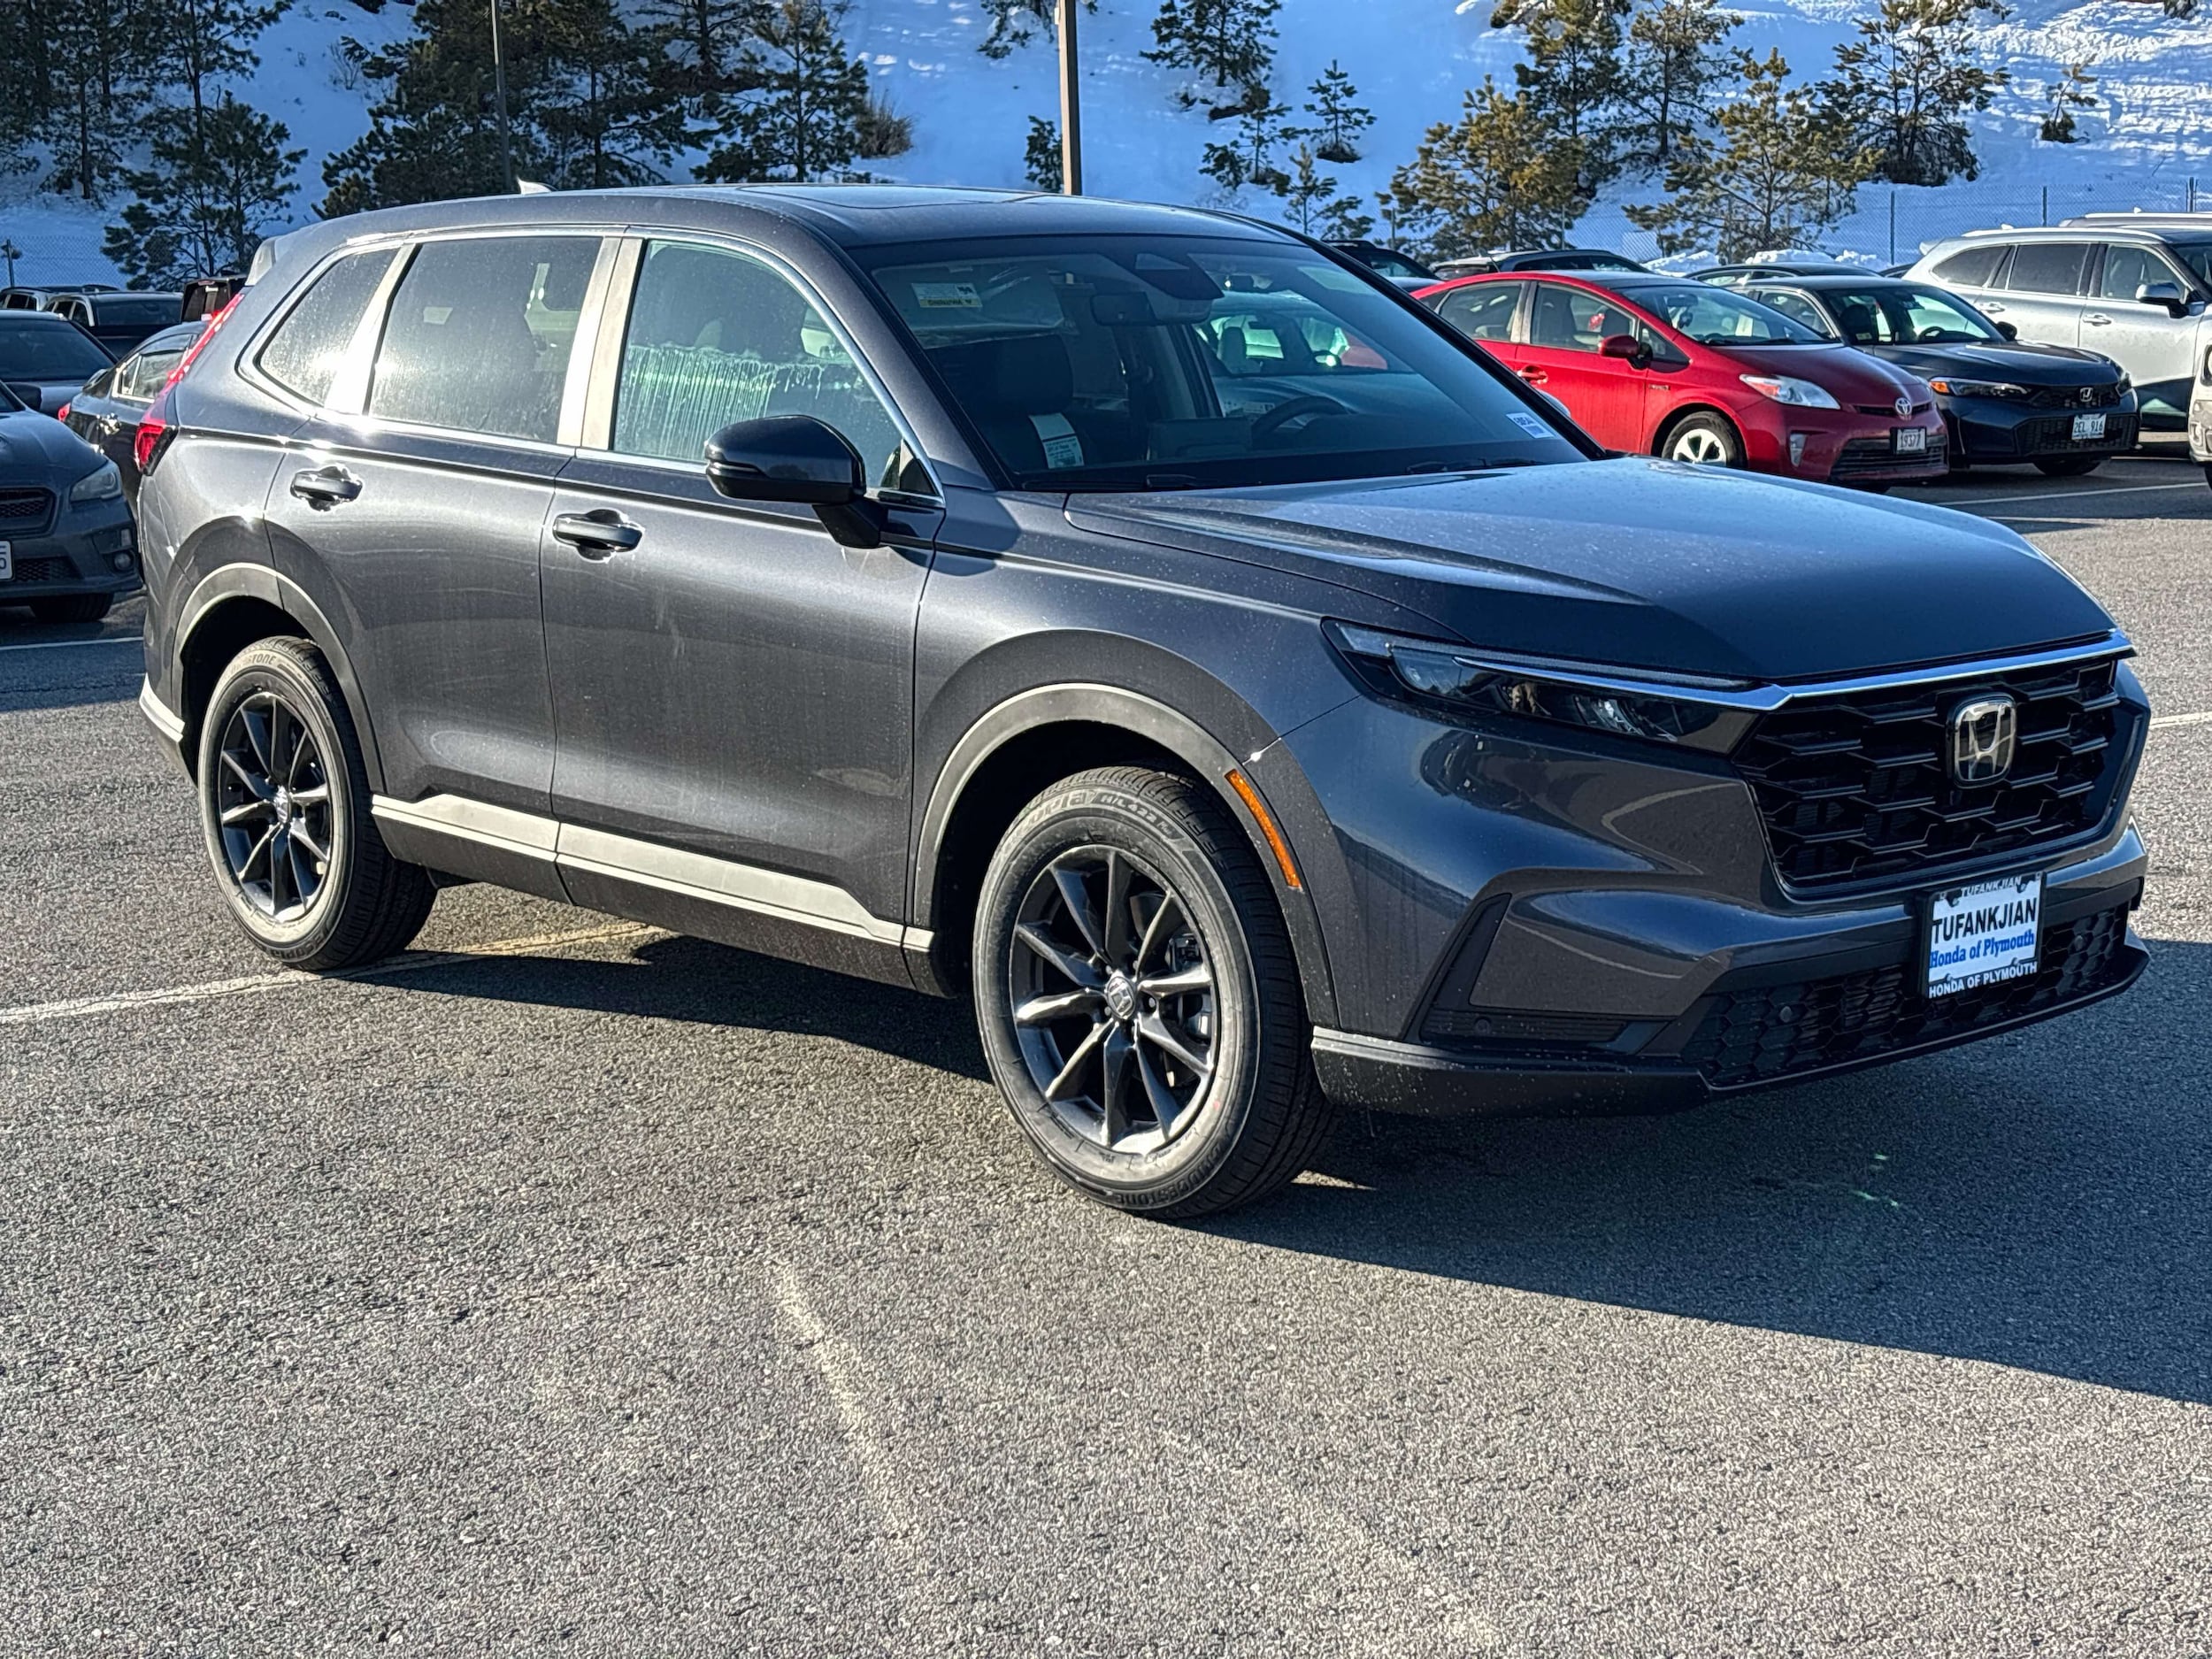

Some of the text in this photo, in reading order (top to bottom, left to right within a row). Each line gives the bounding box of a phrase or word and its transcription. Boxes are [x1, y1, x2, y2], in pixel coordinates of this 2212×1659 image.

[1961, 876, 2022, 897] TUFANKJIAN
[1932, 897, 2037, 944] TUFANKJIAN
[1931, 929, 2034, 968] Honda of Plymouth
[1929, 961, 2038, 999] HONDA OF PLYMOUTH
